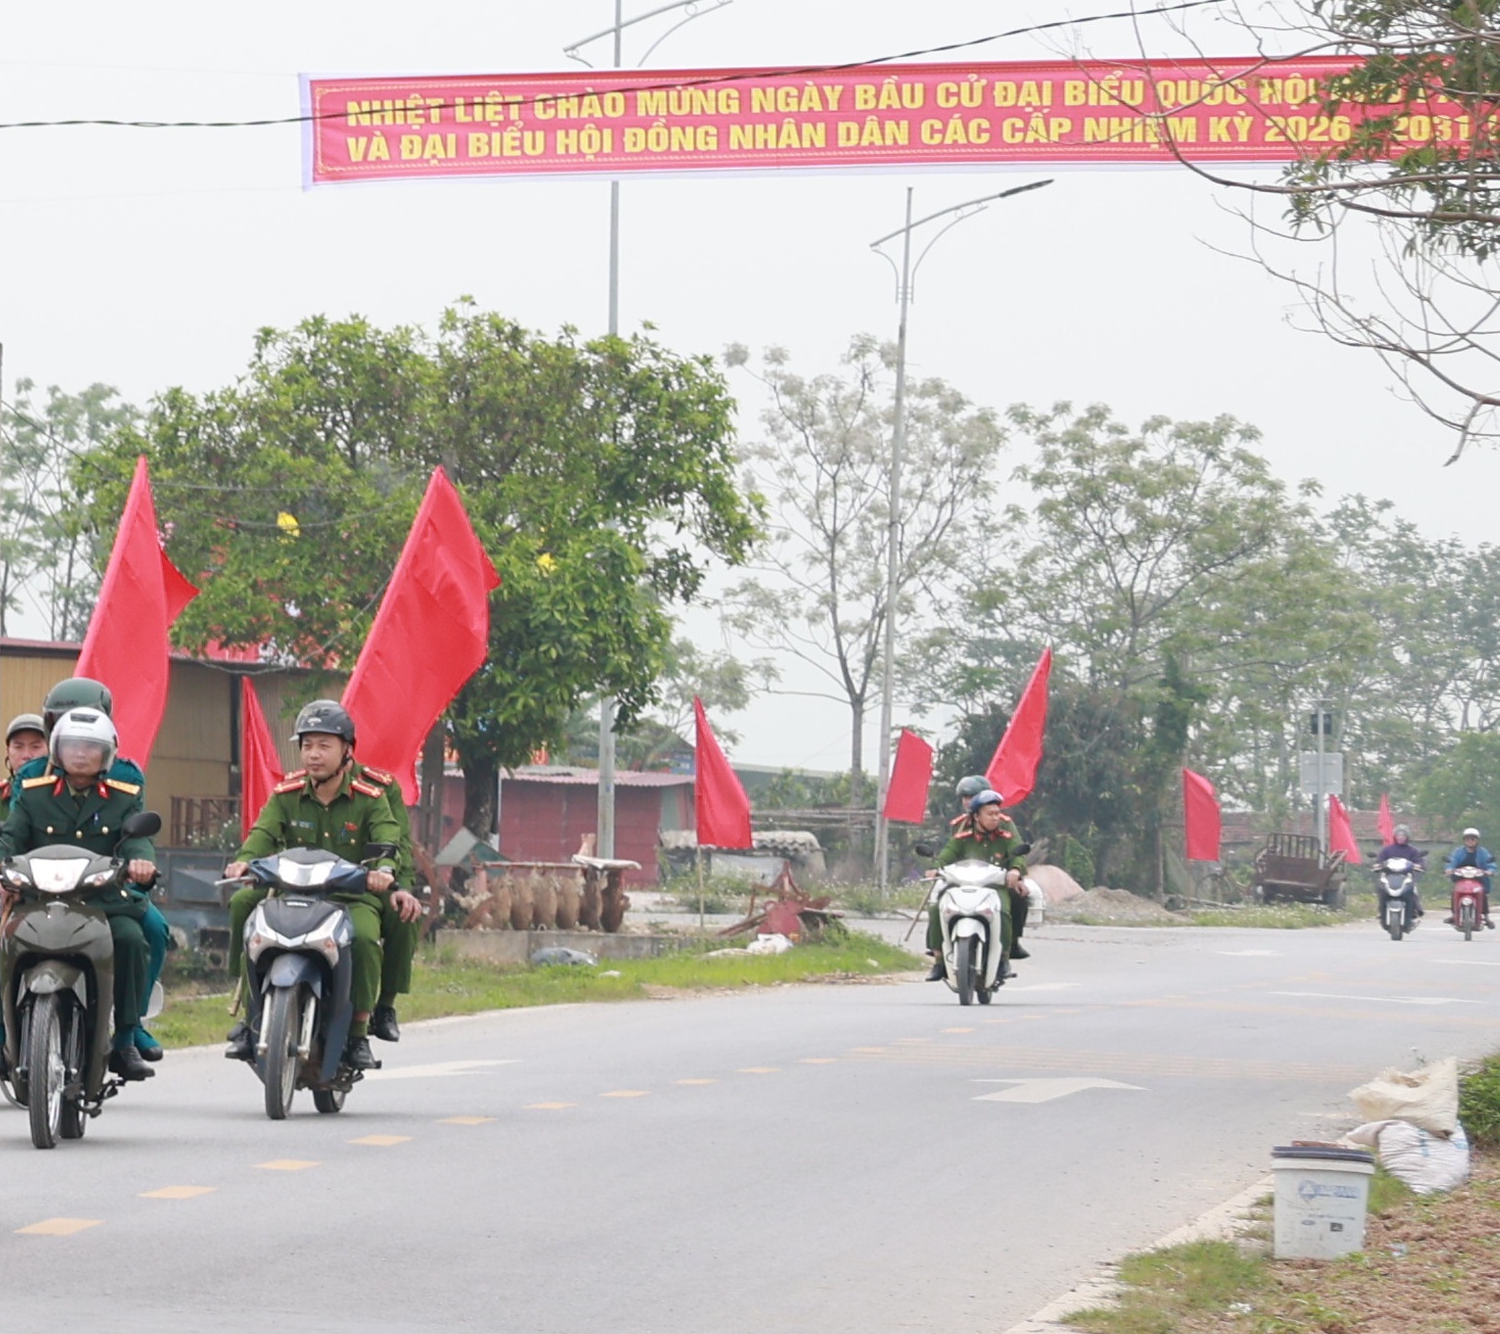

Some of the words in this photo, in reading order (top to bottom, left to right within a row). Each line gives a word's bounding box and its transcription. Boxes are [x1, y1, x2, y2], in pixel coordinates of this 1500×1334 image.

[346, 93, 445, 129] NHIỆT
[455, 90, 524, 127] LIỆT
[534, 87, 626, 120] CHÀO
[637, 85, 741, 117] MỪNG
[751, 81, 844, 114] NGÀY
[855, 75, 924, 111] BẦU
[937, 73, 988, 108] CỬ
[993, 80, 1053, 113] ĐẠI
[1064, 70, 1144, 107] BIỂU
[1155, 70, 1249, 109] QUỐC
[346, 130, 391, 163] VÀ
[400, 133, 457, 166] ĐẠI
[468, 120, 546, 159] BIỂU
[556, 123, 613, 162] HỘI
[623, 118, 719, 154] ĐỒNG
[729, 117, 827, 151] NHÂN
[838, 115, 910, 148] DÂN
[919, 113, 990, 146] CÁC
[1002, 108, 1072, 144] CẤP
[1084, 112, 1198, 150] NHIỆM
[1209, 111, 1254, 143] KỲ
[1264, 114, 1353, 143] 2026
[1392, 114, 1470, 143] 2031
